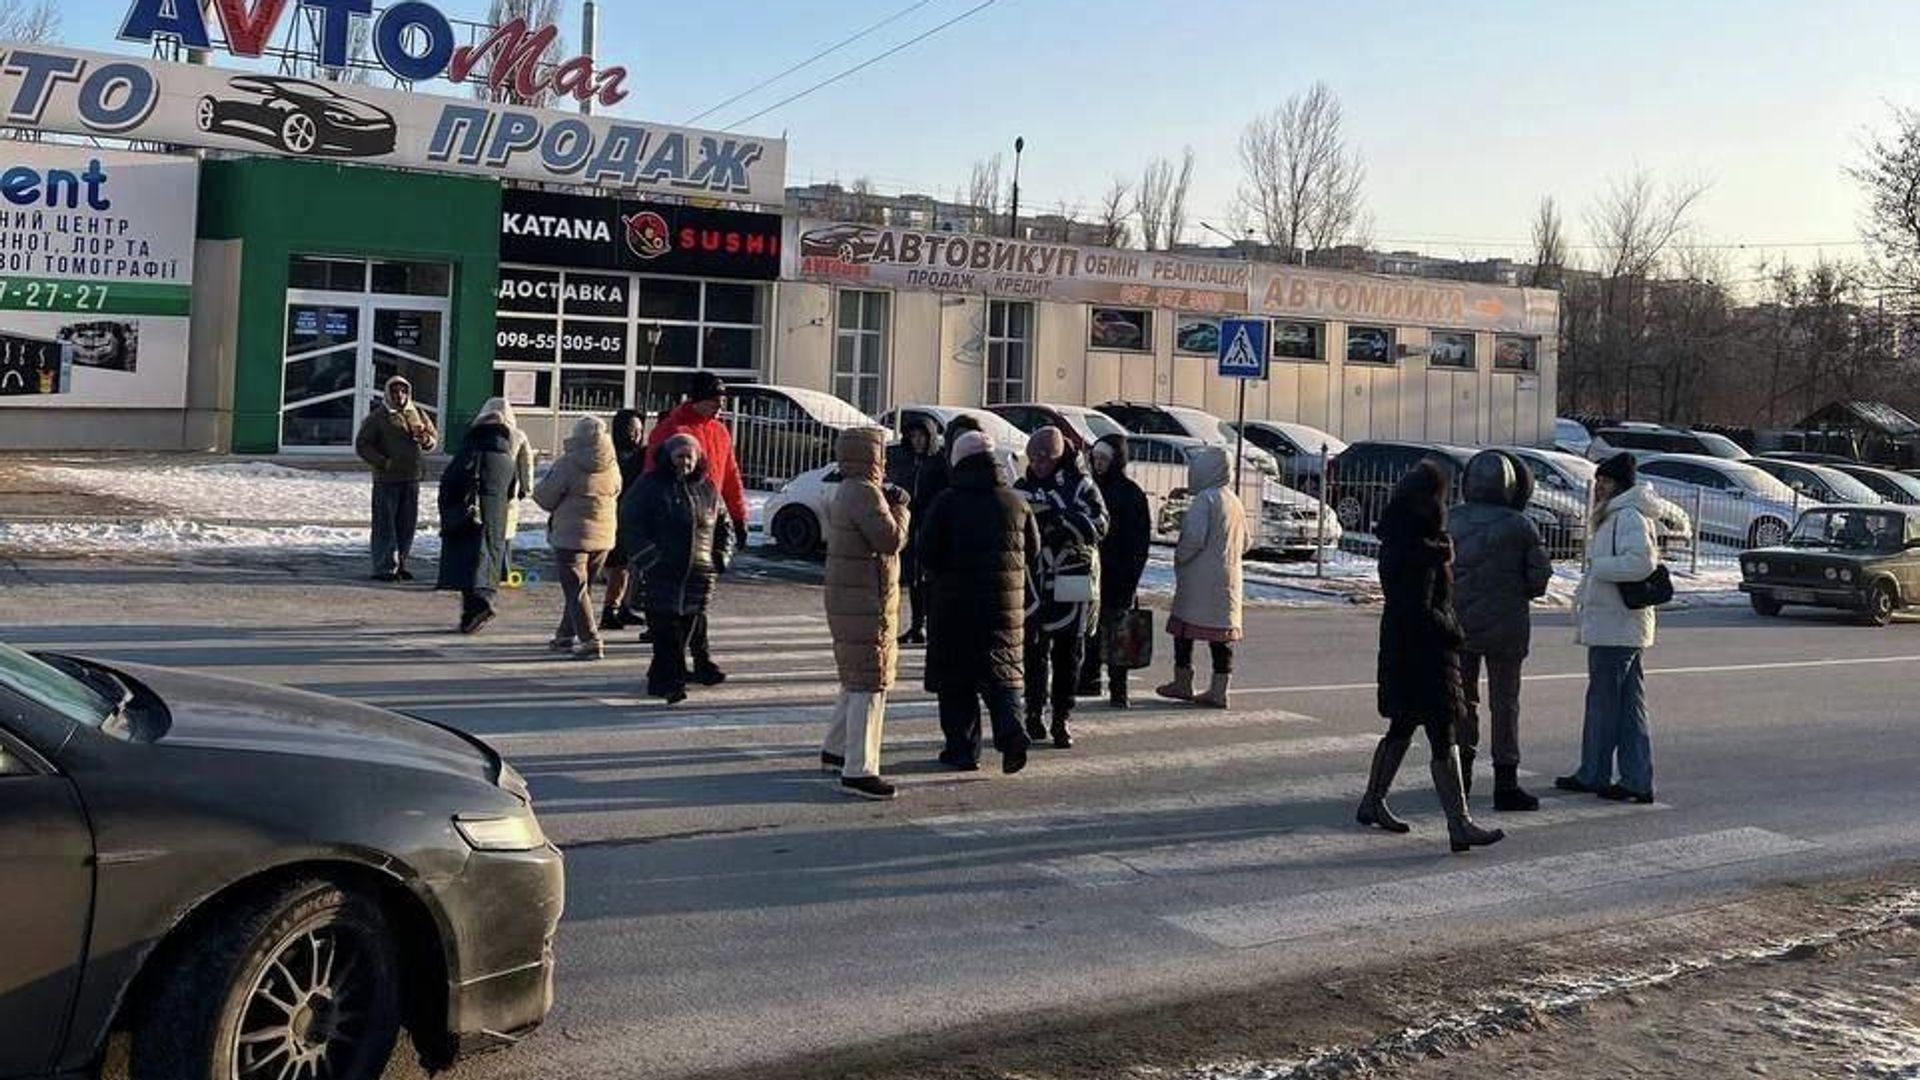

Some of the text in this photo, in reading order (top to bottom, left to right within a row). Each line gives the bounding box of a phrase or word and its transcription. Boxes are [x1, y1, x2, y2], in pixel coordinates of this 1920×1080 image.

[428, 103, 762, 194] ПРОДАЖ
[1, 159, 110, 211] ent
[57, 215, 128, 236] ЦЕНТР
[502, 213, 778, 256] KATANA SUSHI
[72, 236, 115, 255] ЛОР
[127, 239, 149, 257] ТА
[45, 254, 177, 279] ТОМОГРАФІЇ
[873, 231, 1080, 276] АВТОВИКУП
[1085, 254, 1140, 278] ОБМІН
[1152, 260, 1248, 288] РЕАЛІЗАЦІЯ
[498, 279, 623, 303] ДОСТАВКА
[907, 270, 1054, 295] ПРОДАЖ КРЕДИТ
